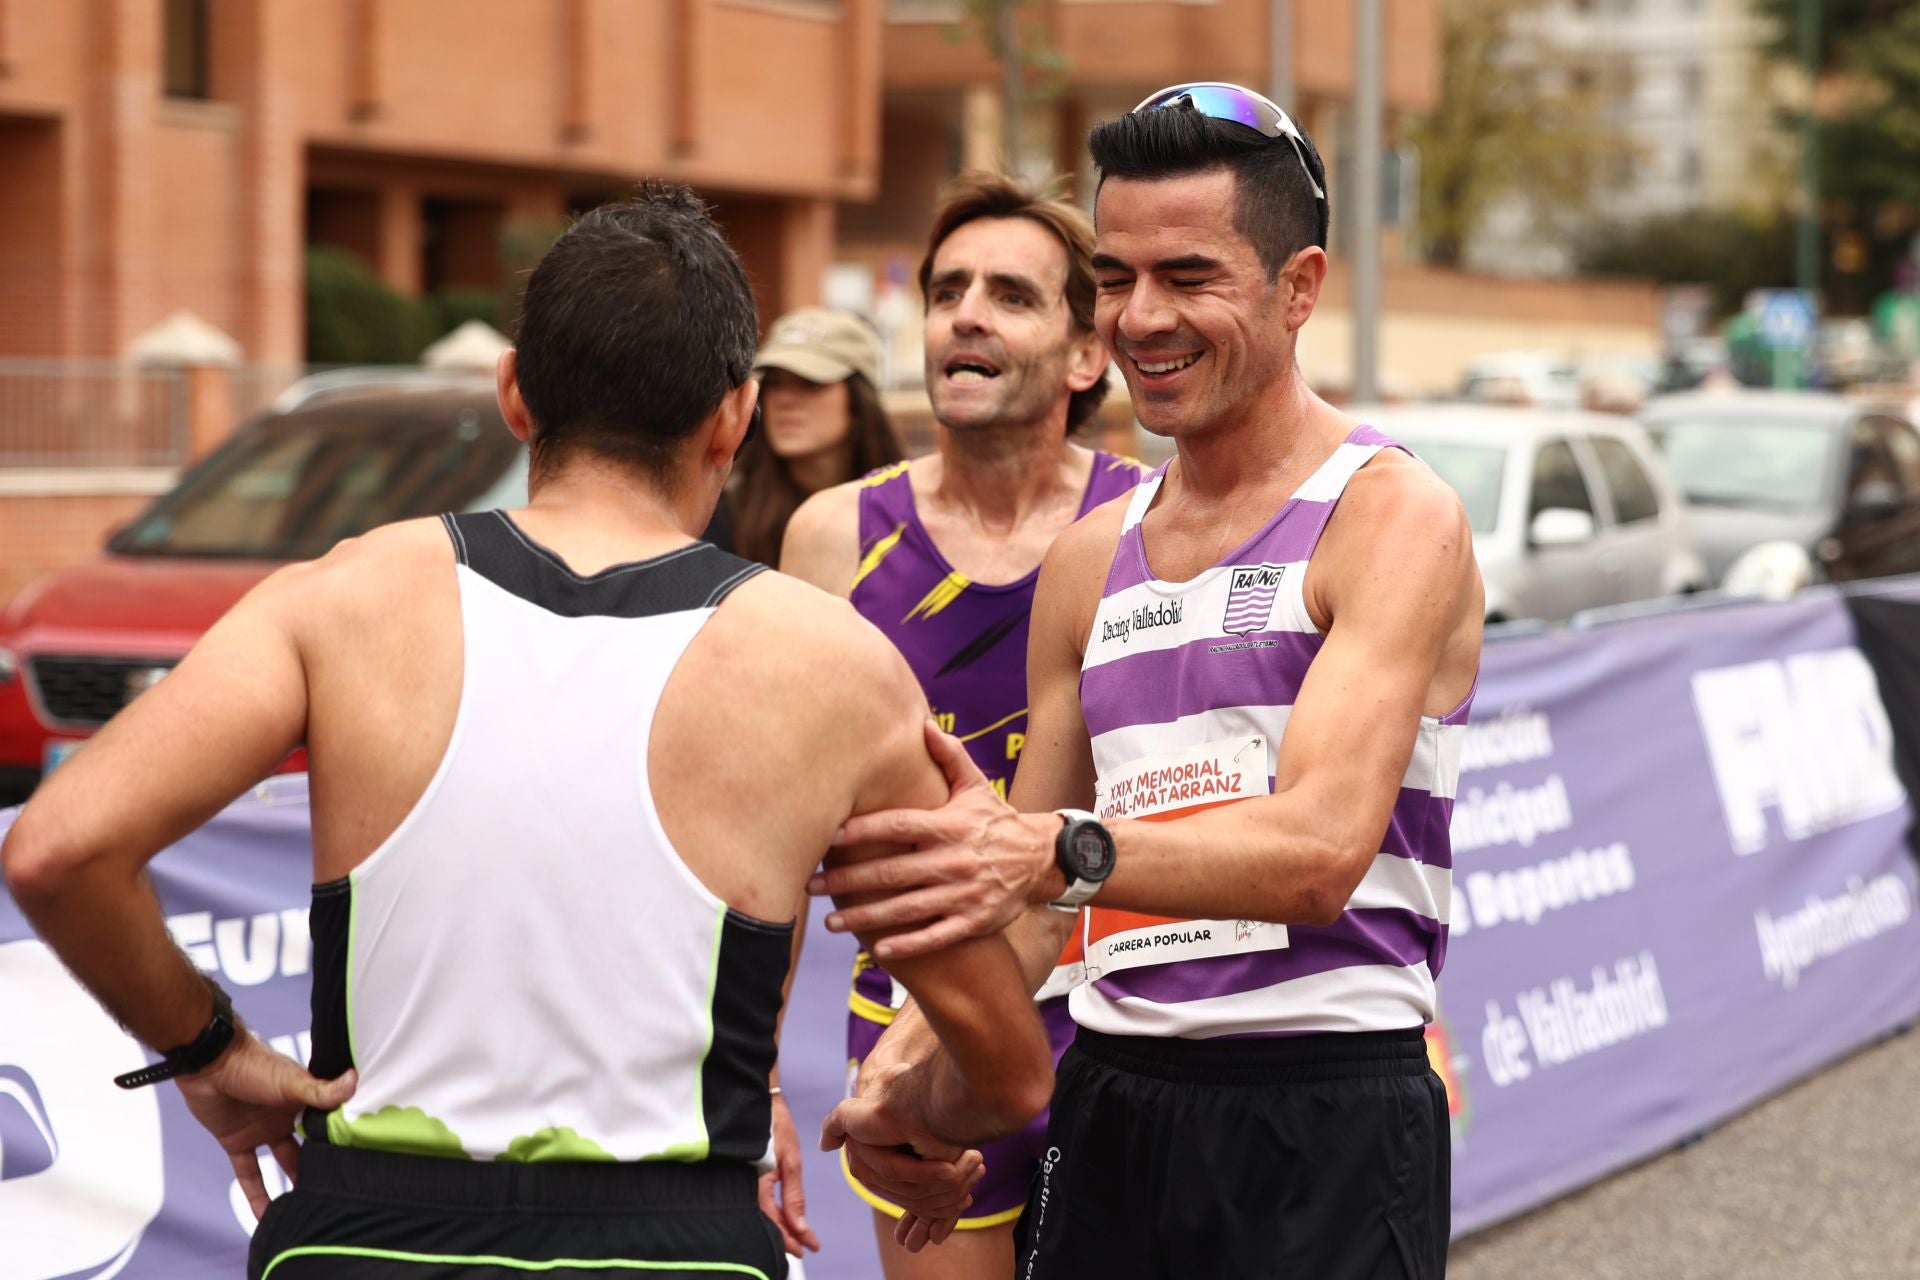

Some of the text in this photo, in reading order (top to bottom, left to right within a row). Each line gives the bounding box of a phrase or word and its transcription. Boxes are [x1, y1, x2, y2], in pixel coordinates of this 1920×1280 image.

[1102, 597, 1184, 643] Racing Valladolid
[1100, 772, 1242, 819] VIDAL-MATARRANZ
[1110, 757, 1223, 803] XXIX MEMORIAL
[1108, 929, 1212, 956] CARRERA POPULAR
